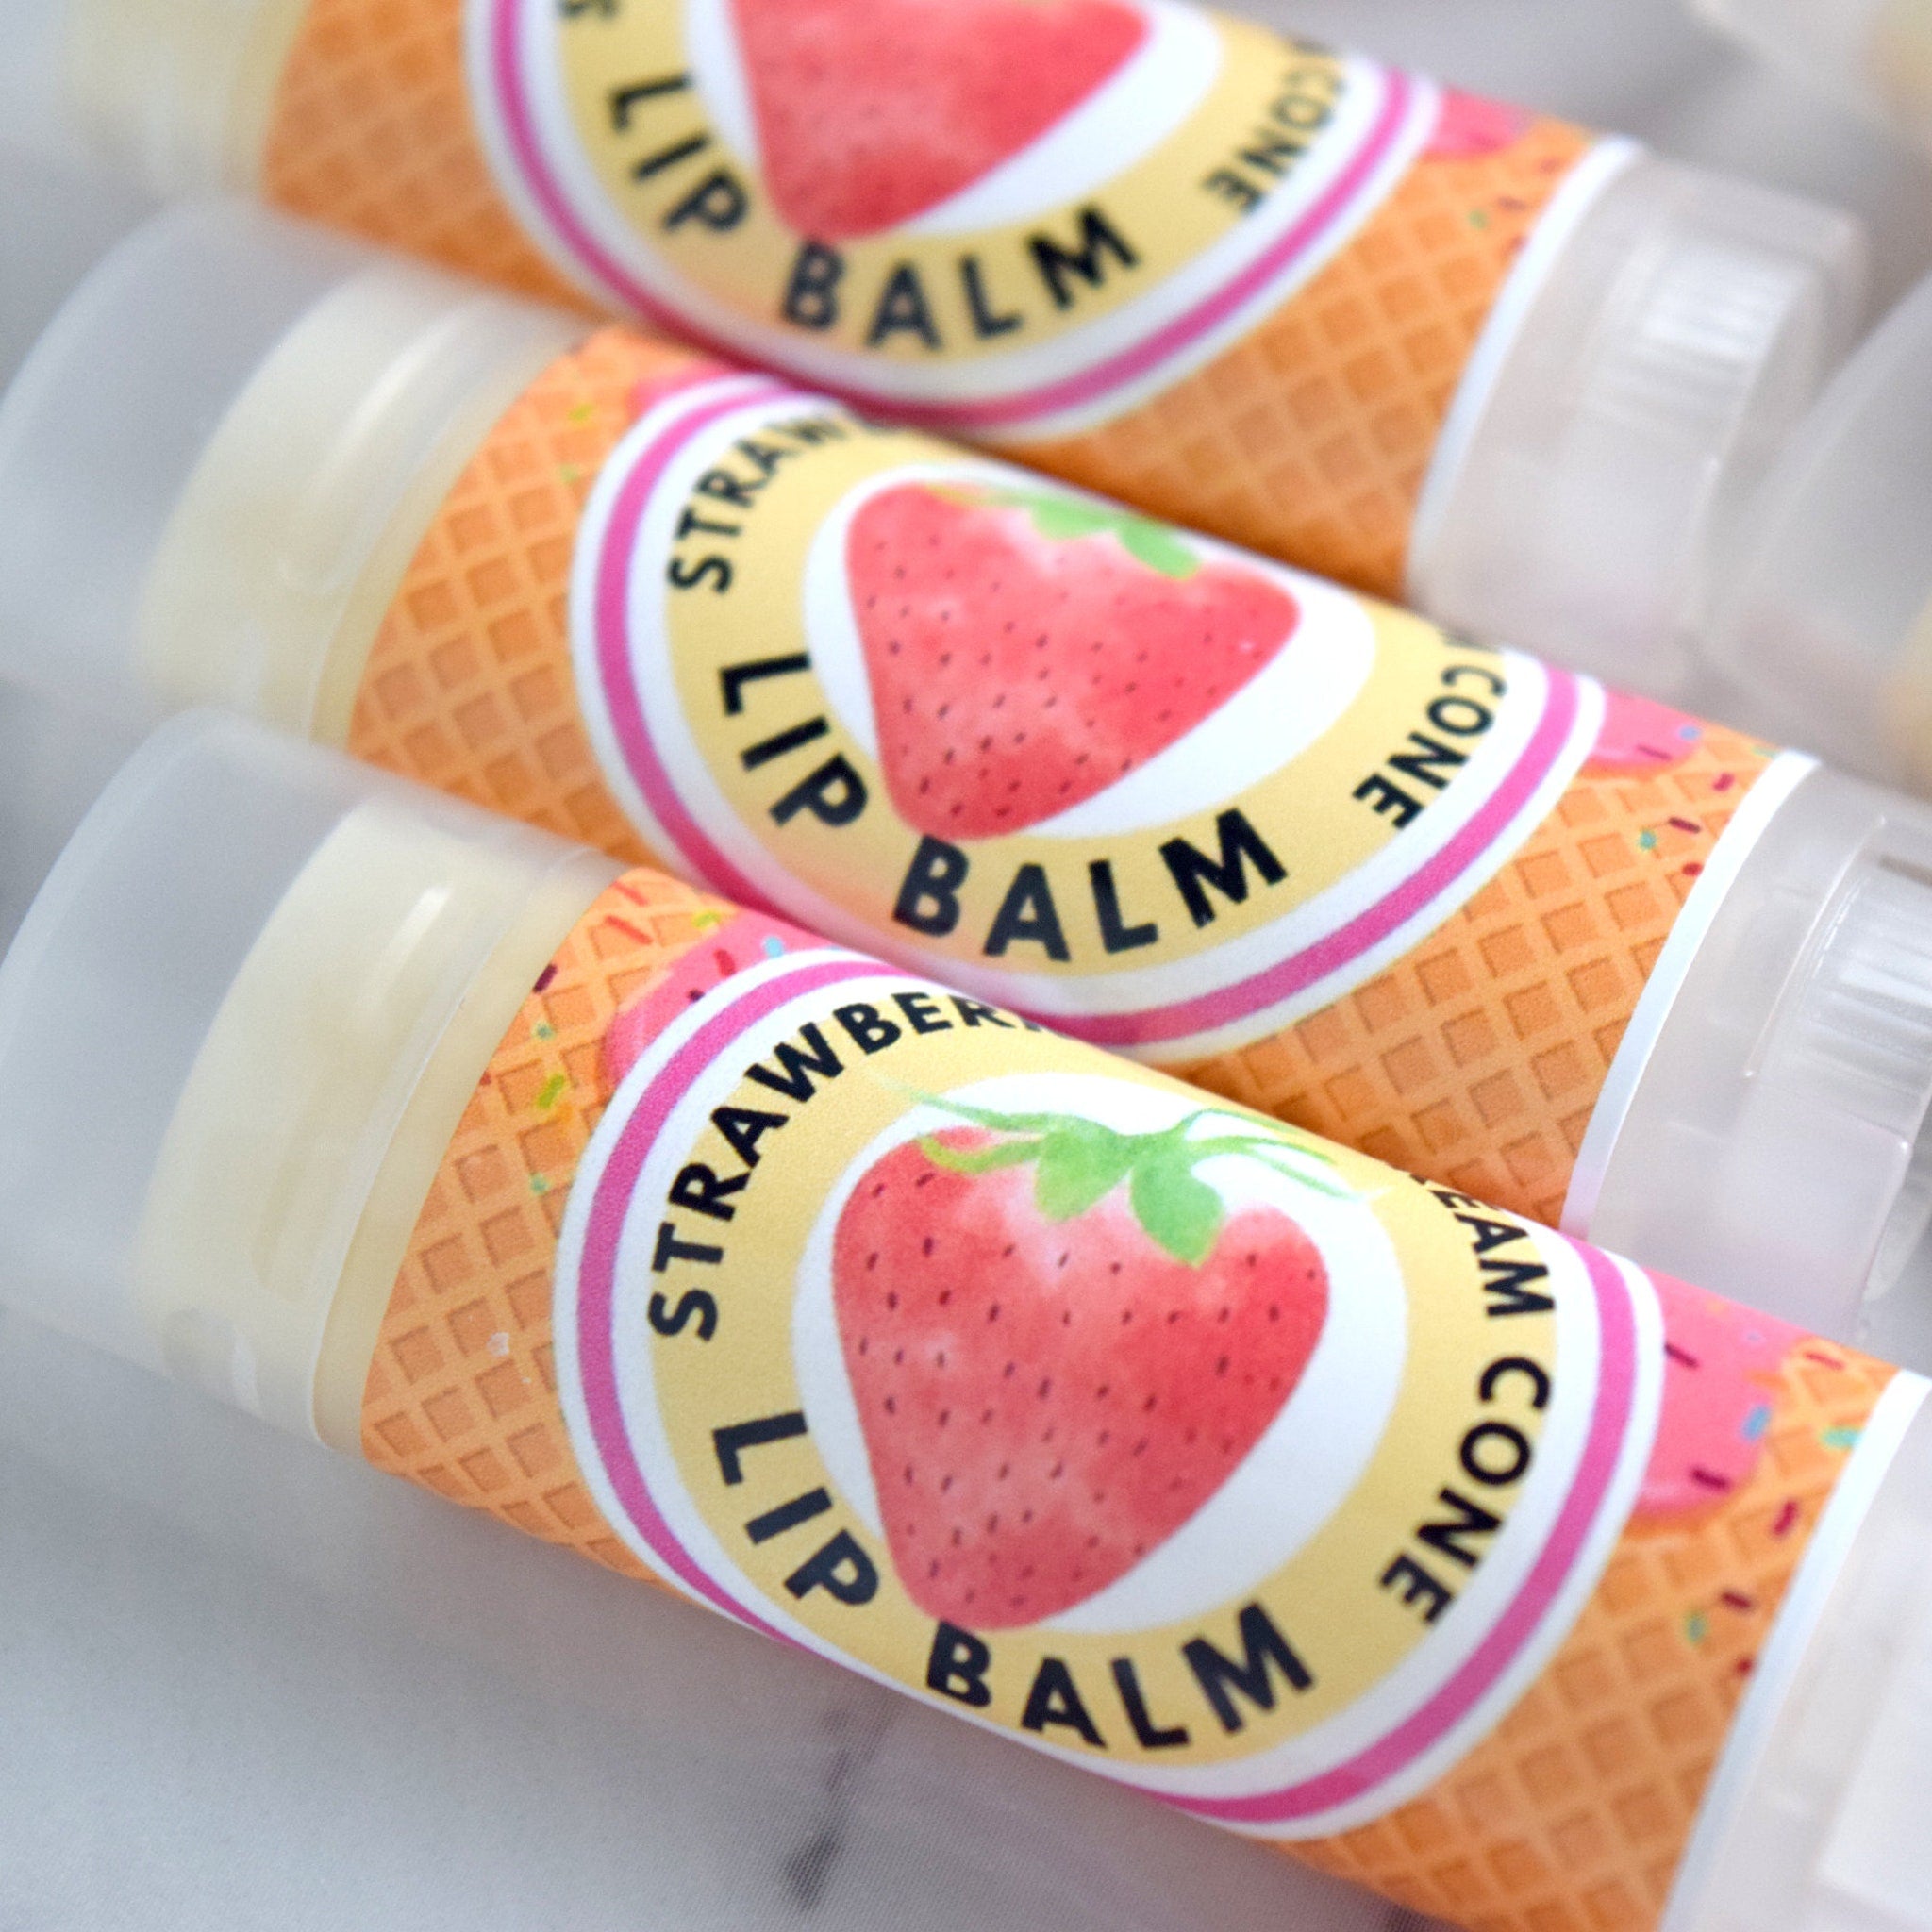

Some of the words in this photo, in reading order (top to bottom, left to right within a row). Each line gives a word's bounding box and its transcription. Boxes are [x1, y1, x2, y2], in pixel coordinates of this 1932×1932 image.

[607, 73, 752, 236] LIP
[779, 205, 1141, 352] BALM
[718, 651, 869, 828] LIP
[892, 806, 1289, 963] BALM
[1352, 664, 1507, 830] CONE
[648, 991, 1041, 1341] STRAWBER
[1410, 1174, 1555, 1317] EAM
[712, 1409, 880, 1608] LIP
[925, 1601, 1314, 1750] BALM
[1378, 1356, 1552, 1625] CONE
